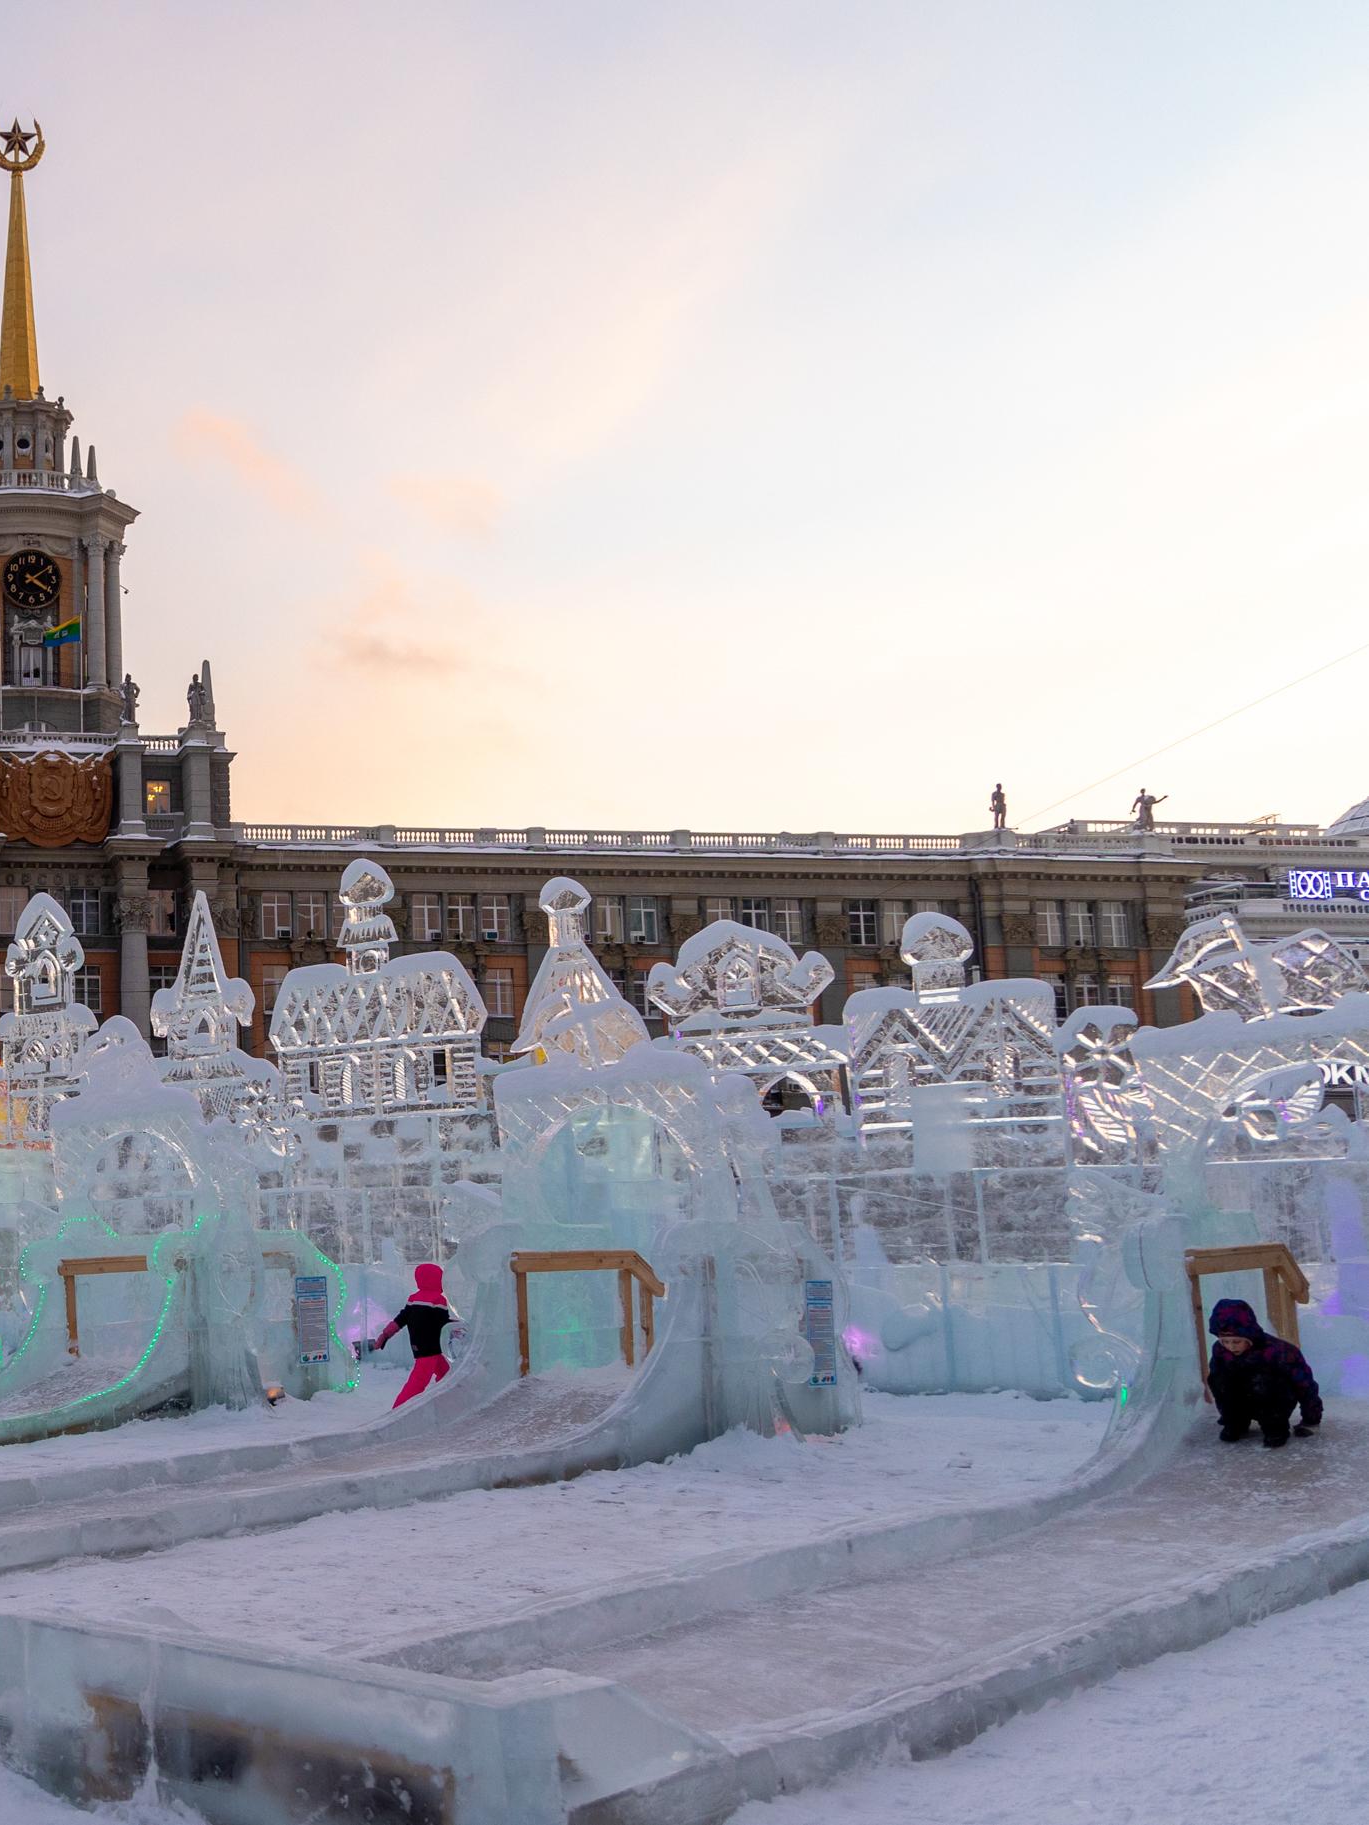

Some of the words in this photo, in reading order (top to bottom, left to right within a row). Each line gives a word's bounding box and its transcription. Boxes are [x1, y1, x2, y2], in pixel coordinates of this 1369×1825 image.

[19, 557, 25, 565] 11
[10, 564, 19, 572] 10
[7, 573, 14, 582] 9
[51, 575, 57, 584] 3
[10, 584, 17, 593] 8
[18, 592, 24, 600] 7
[28, 595, 35, 604] 6
[39, 593, 46, 601] 5
